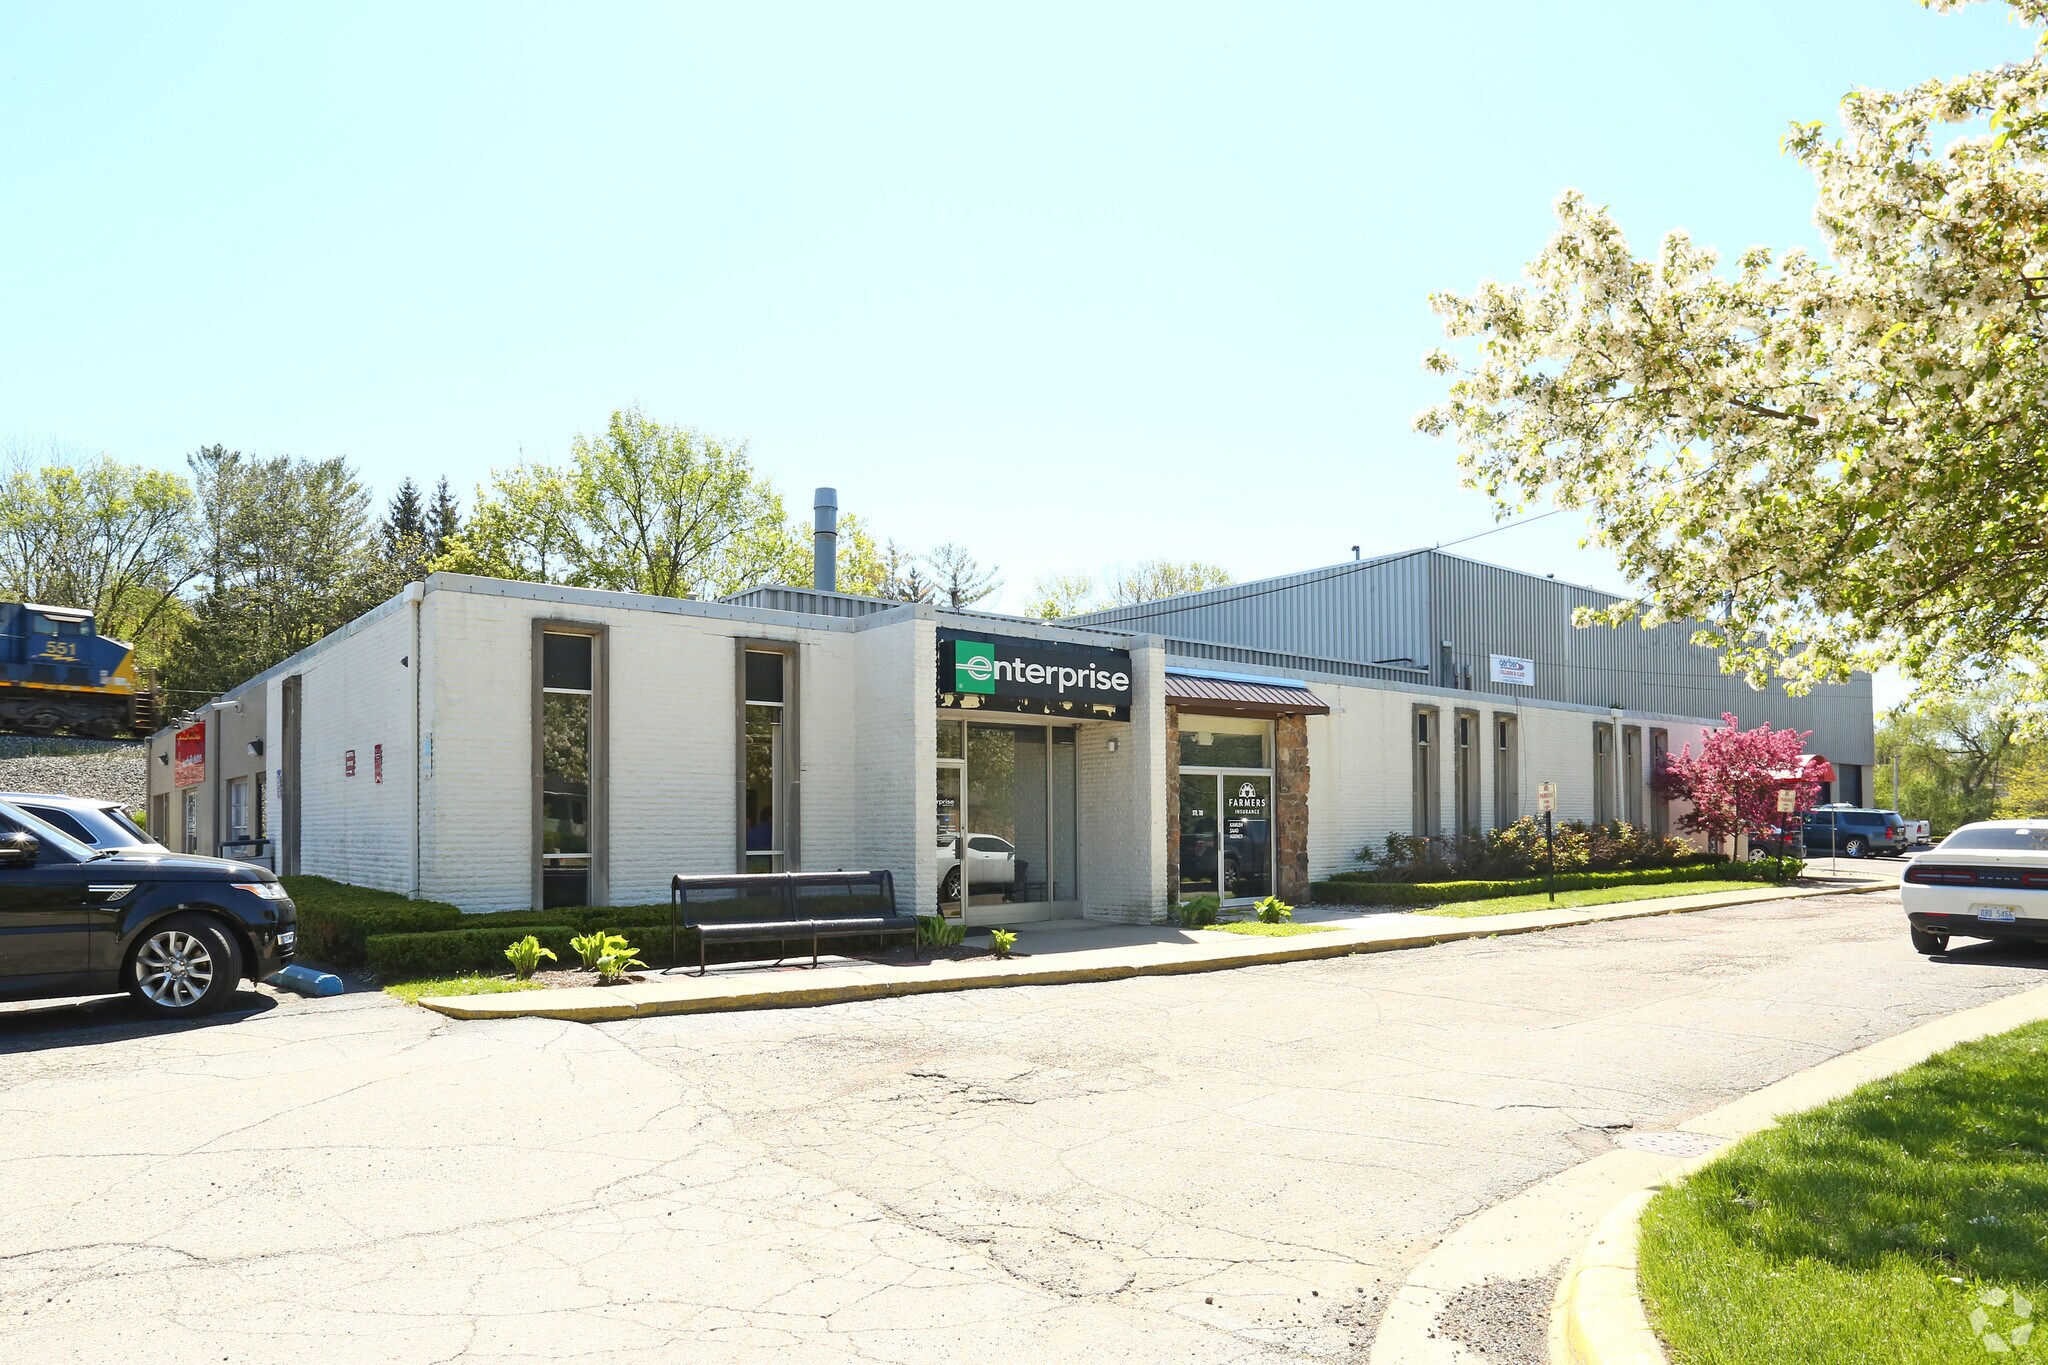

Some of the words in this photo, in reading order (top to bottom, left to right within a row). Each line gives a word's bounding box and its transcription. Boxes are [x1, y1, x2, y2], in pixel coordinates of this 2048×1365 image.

[46, 641, 76, 656] 551
[956, 655, 1130, 693] enterprise
[1228, 798, 1266, 807] FARMERS
